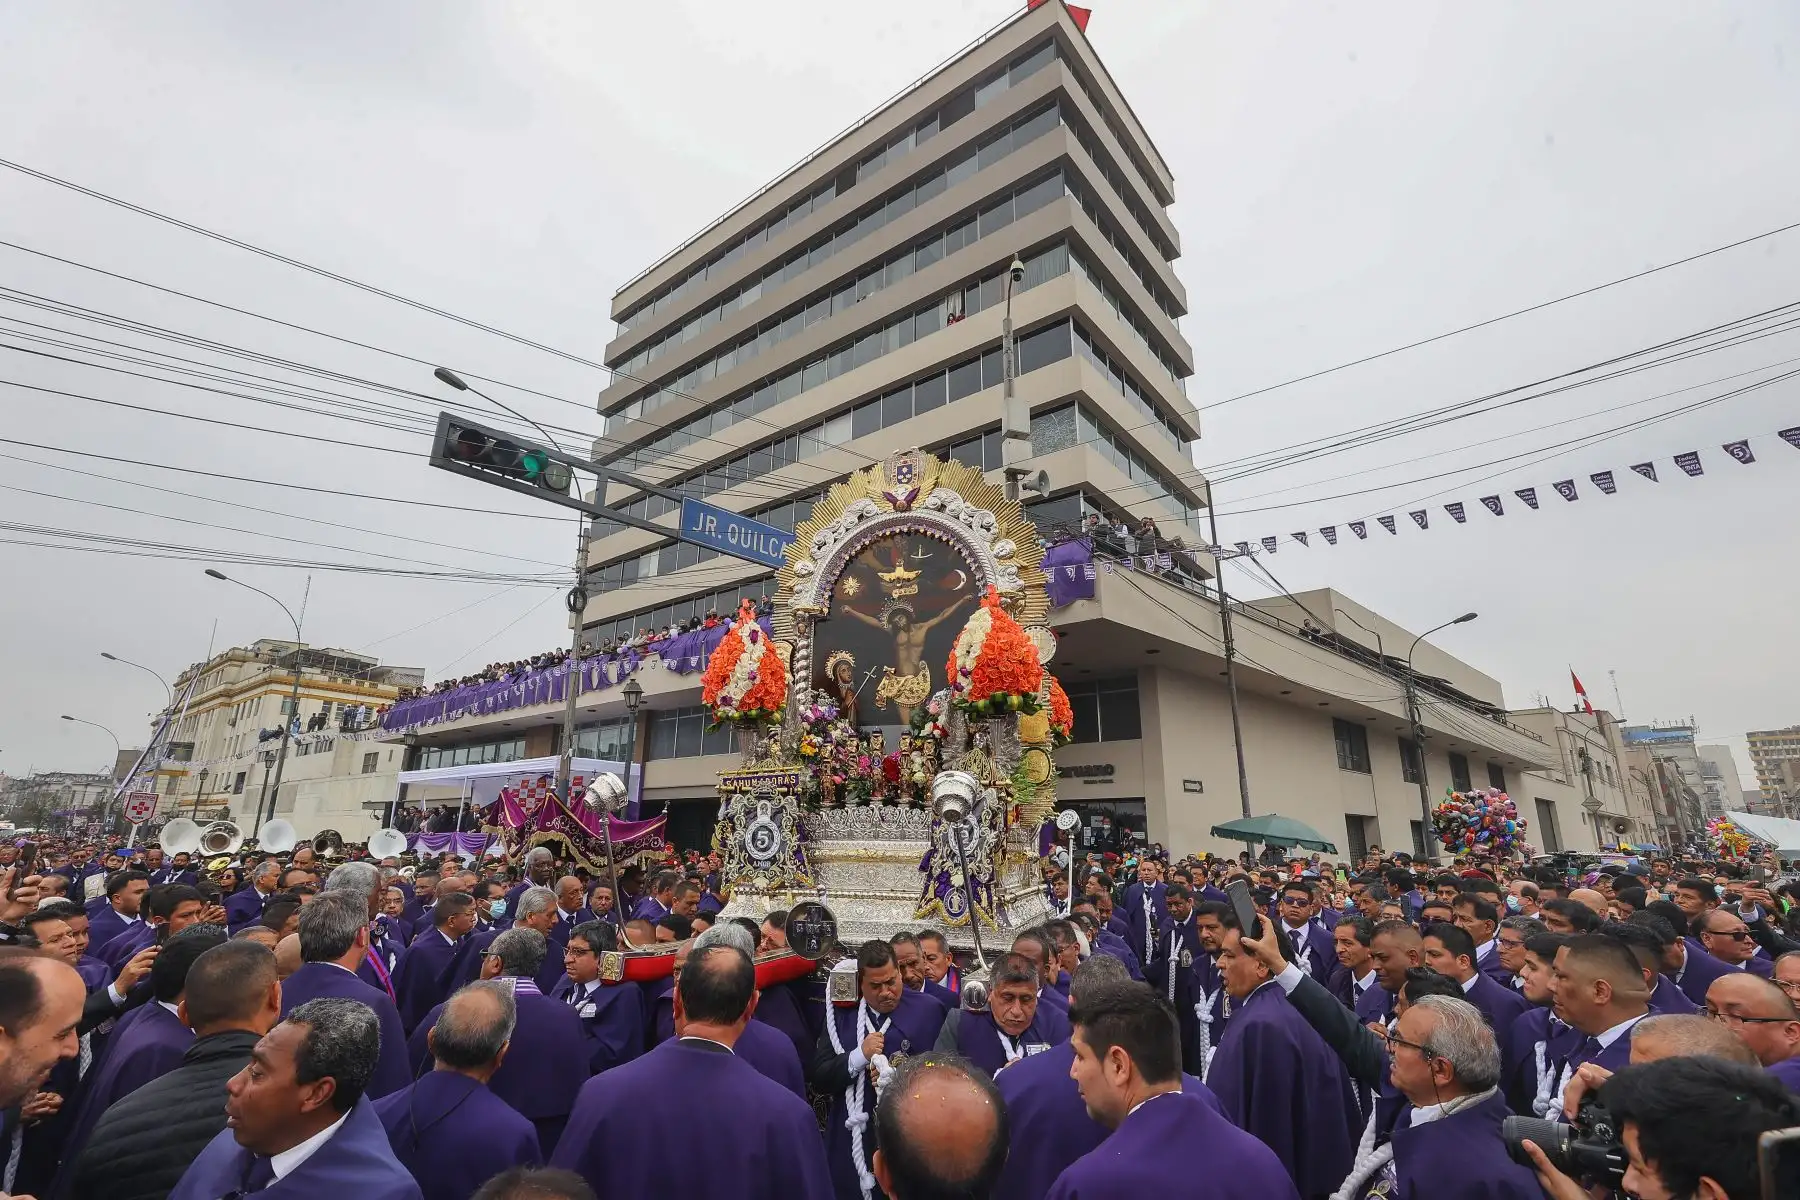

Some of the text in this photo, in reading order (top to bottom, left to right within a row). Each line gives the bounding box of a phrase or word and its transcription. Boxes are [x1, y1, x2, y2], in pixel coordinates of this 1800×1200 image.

[1733, 447, 1744, 458] 5
[1561, 486, 1570, 496] 5
[1488, 502, 1496, 511] 5
[692, 512, 722, 539] JR.
[726, 775, 796, 787] SAHUMDORAS
[757, 830, 769, 849] 5
